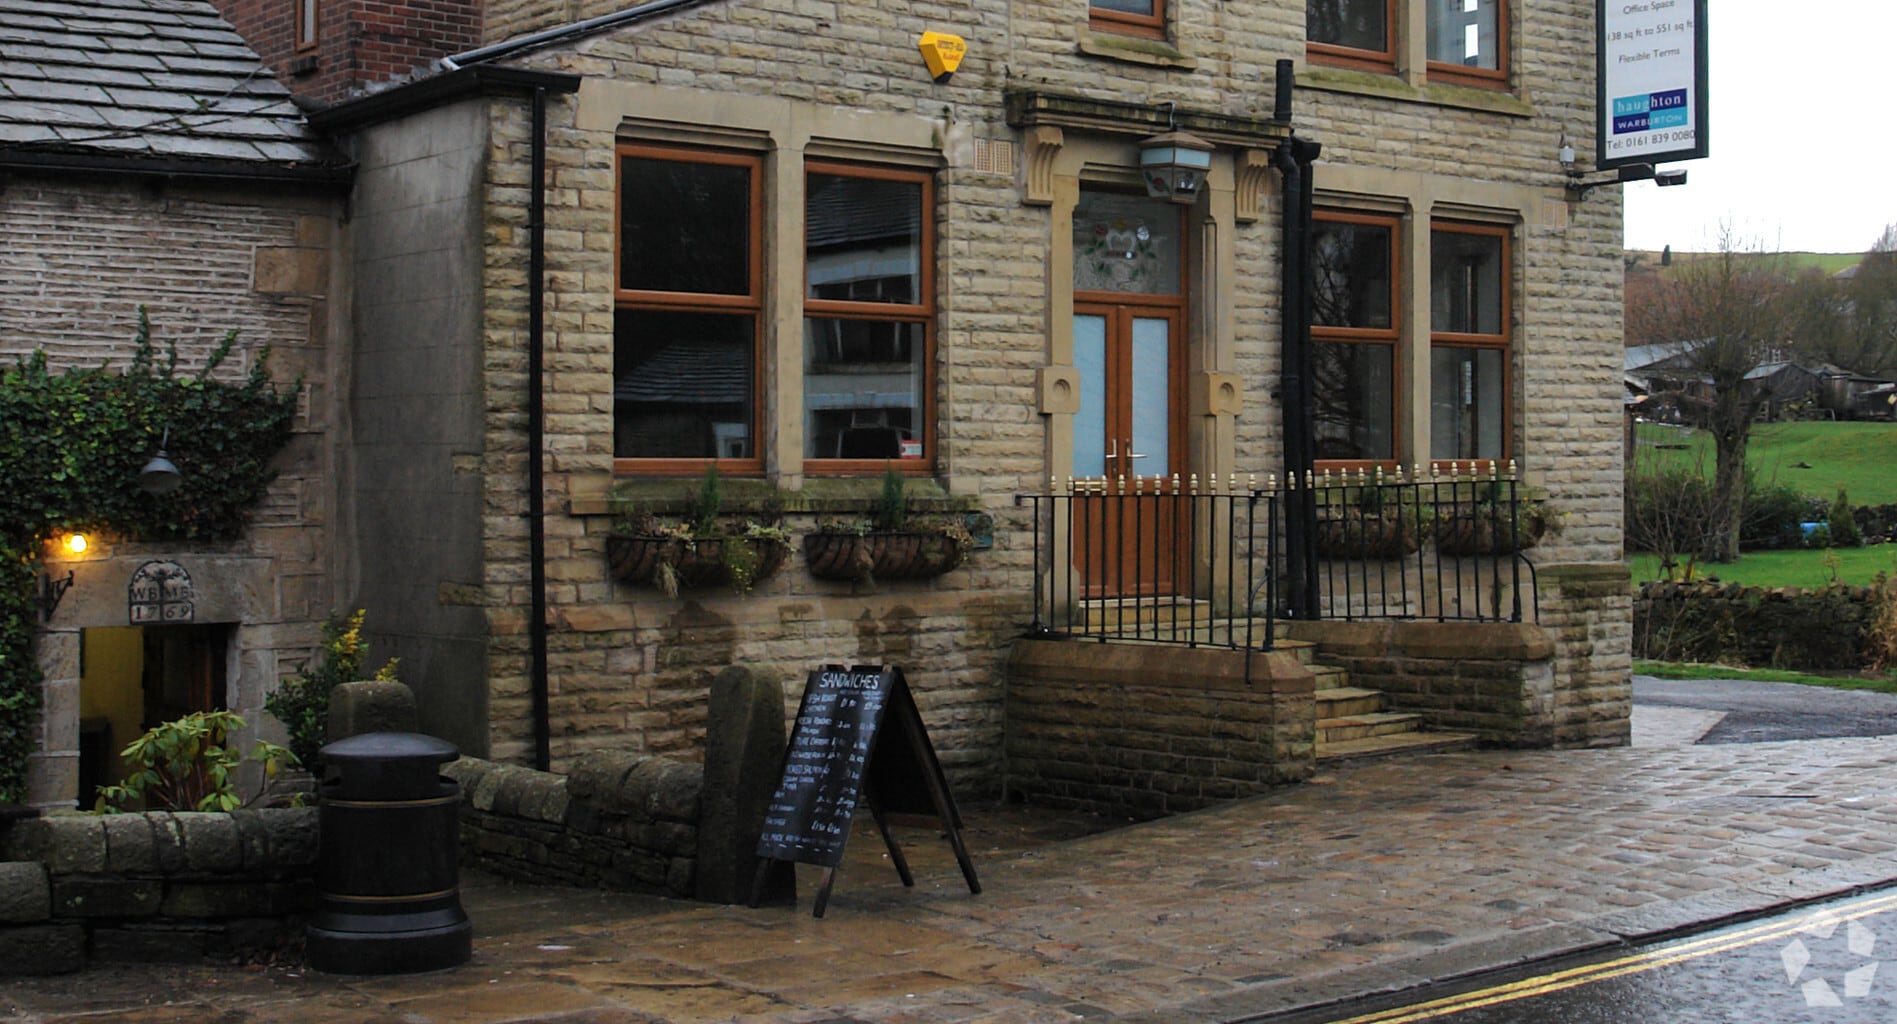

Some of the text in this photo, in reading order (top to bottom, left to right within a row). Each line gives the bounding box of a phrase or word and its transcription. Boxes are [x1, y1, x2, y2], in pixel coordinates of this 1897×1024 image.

[1623, 0, 1675, 15] Office Space
[1656, 24, 1671, 34] 551
[1619, 48, 1680, 64] Flexible Terms
[1618, 96, 1681, 113] haughton
[1618, 115, 1682, 129] WARBURTON
[1608, 130, 1694, 150] Tel: 0161 839 0080
[819, 672, 880, 690] SANDWICHES
